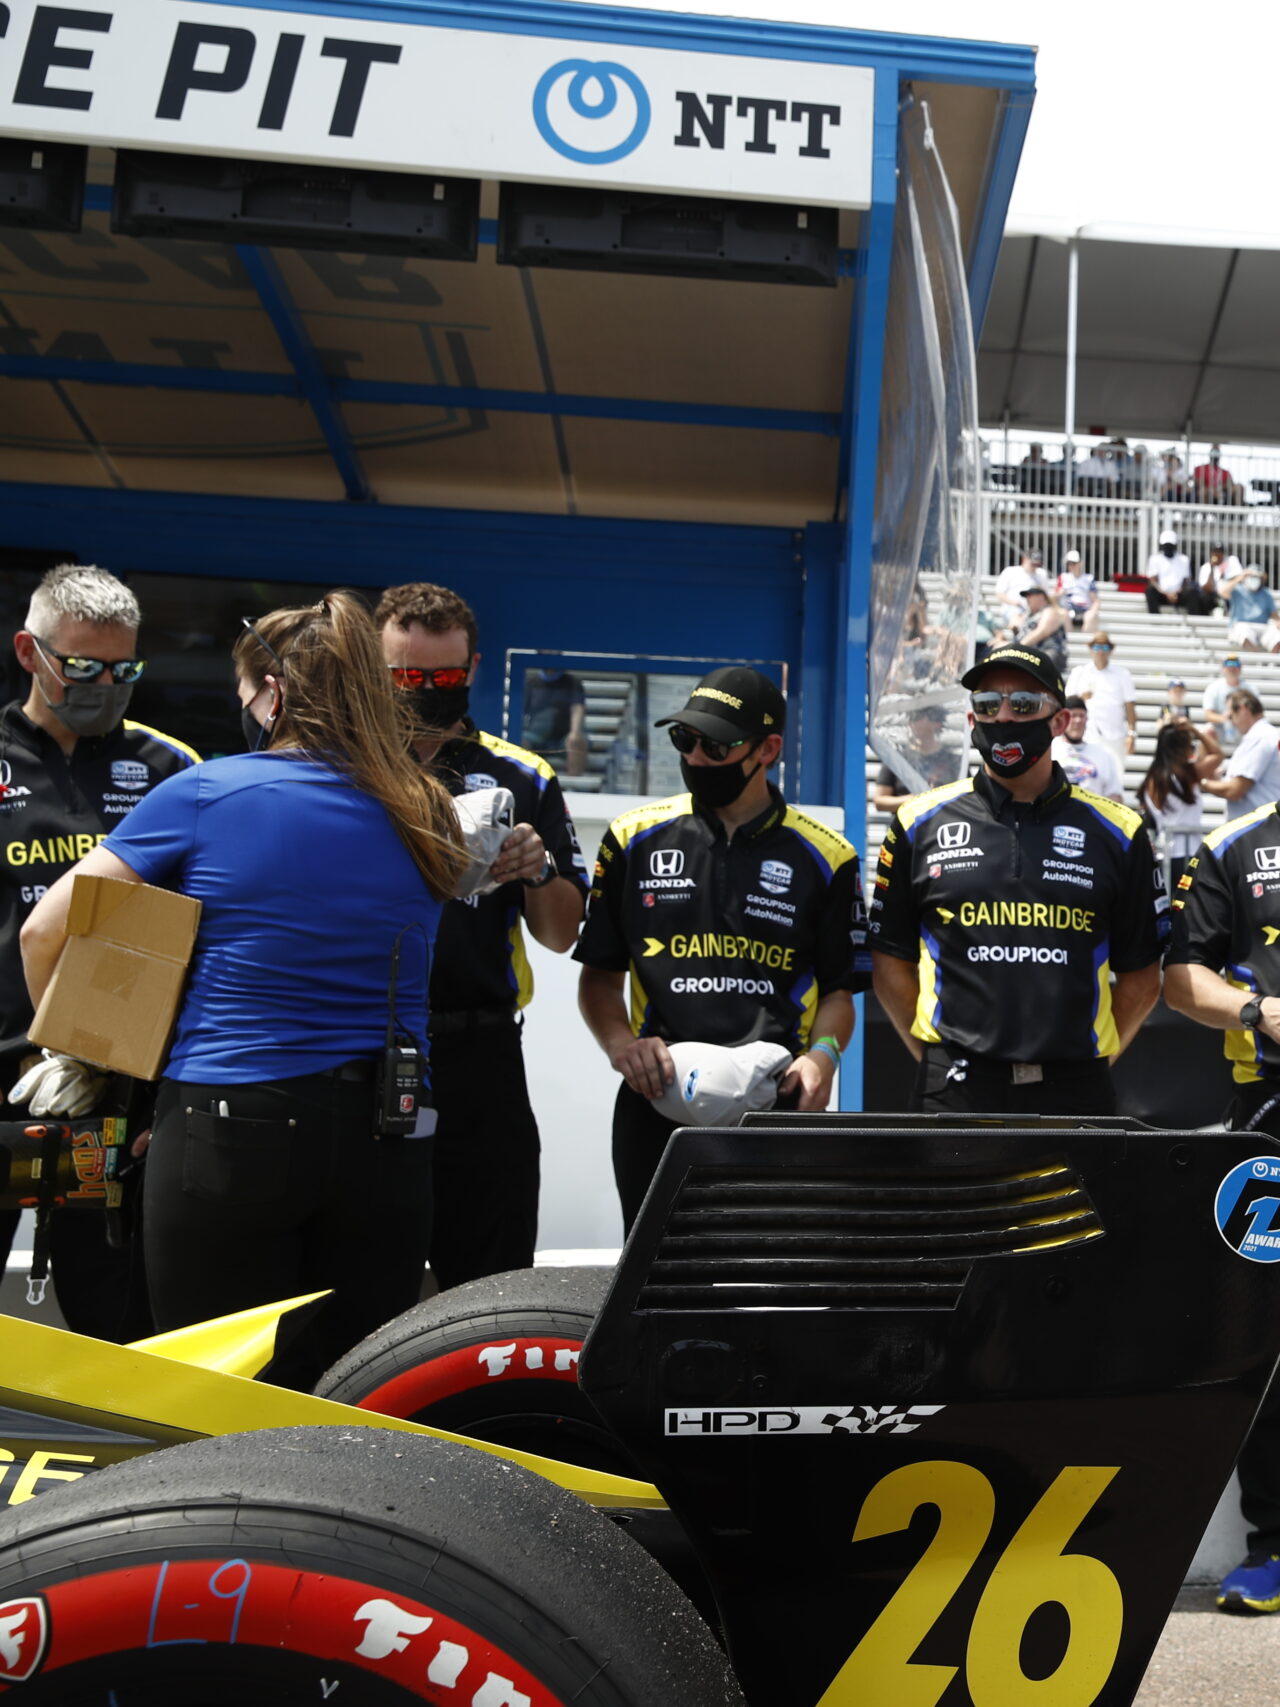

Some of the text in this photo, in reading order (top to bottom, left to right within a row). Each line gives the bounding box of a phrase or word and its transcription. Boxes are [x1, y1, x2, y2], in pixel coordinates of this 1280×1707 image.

[0, 3, 403, 137] E PIT
[674, 91, 841, 159] NTT
[927, 848, 984, 863] HONDA
[1042, 859, 1093, 875] GROUP1001
[639, 878, 697, 890] HONDA
[1042, 871, 1093, 888] AutoNation
[746, 894, 796, 913] GROUP1001
[744, 906, 793, 927] AutoNation
[960, 902, 1095, 932] GAINBRIDGE
[671, 932, 795, 970] GAINBRIDGE
[967, 946, 1068, 965] GROUP1001
[670, 977, 774, 995] GROUP1001
[1243, 1244, 1257, 1252] 2021
[669, 1411, 801, 1434] HPD
[815, 1460, 1124, 1707] 26
